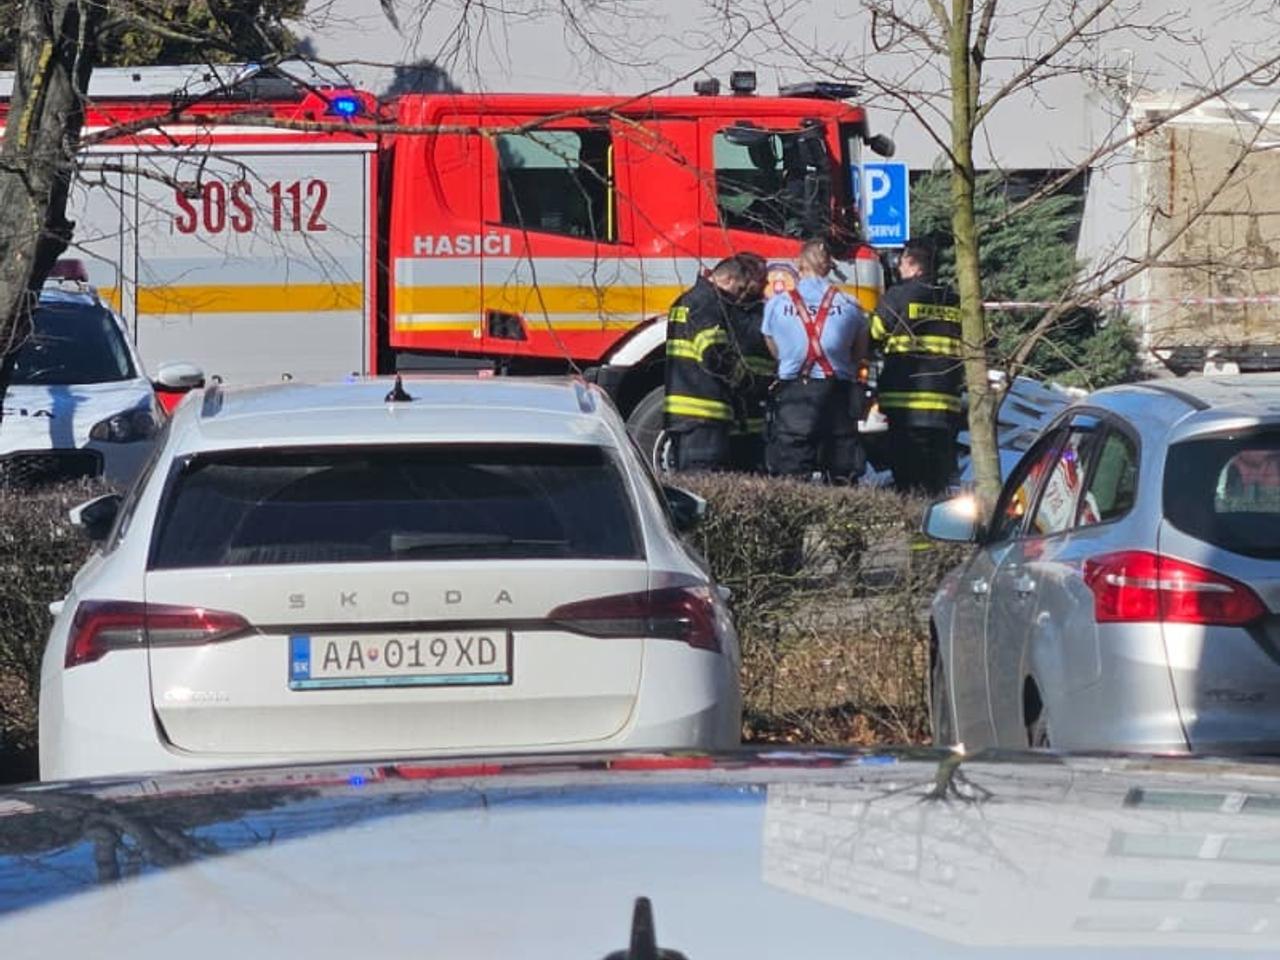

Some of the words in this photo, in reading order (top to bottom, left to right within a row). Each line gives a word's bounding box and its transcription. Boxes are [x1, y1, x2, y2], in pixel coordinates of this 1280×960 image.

[175, 180, 254, 234] SOS
[267, 179, 328, 231] 112
[865, 170, 892, 217] P
[413, 230, 511, 255] HASIČI
[322, 641, 365, 671] AA
[384, 637, 497, 669] 019XD
